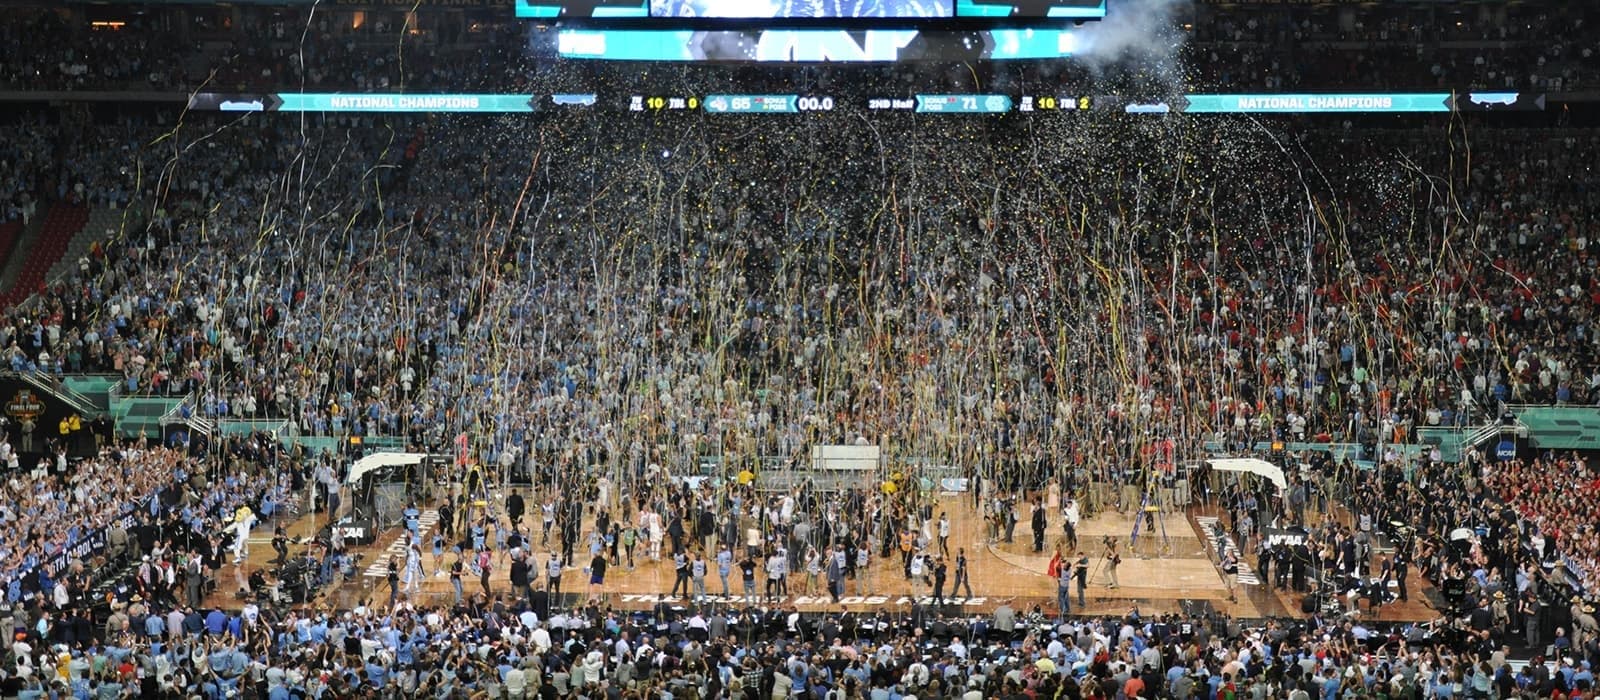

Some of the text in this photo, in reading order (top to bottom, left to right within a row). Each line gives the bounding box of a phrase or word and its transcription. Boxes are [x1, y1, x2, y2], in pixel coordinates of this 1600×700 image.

[331, 97, 479, 108] NATIONAL CHAMPIONS
[647, 97, 664, 109] 10
[688, 97, 698, 109] 0
[798, 97, 834, 110] 00.0
[868, 99, 915, 109] 2ND Half
[961, 97, 978, 110] 71
[1038, 97, 1056, 109] 10
[1079, 98, 1089, 109] 2
[1238, 97, 1393, 108] NATIONAL CHAMPIONS
[1268, 534, 1303, 546] NCAA
